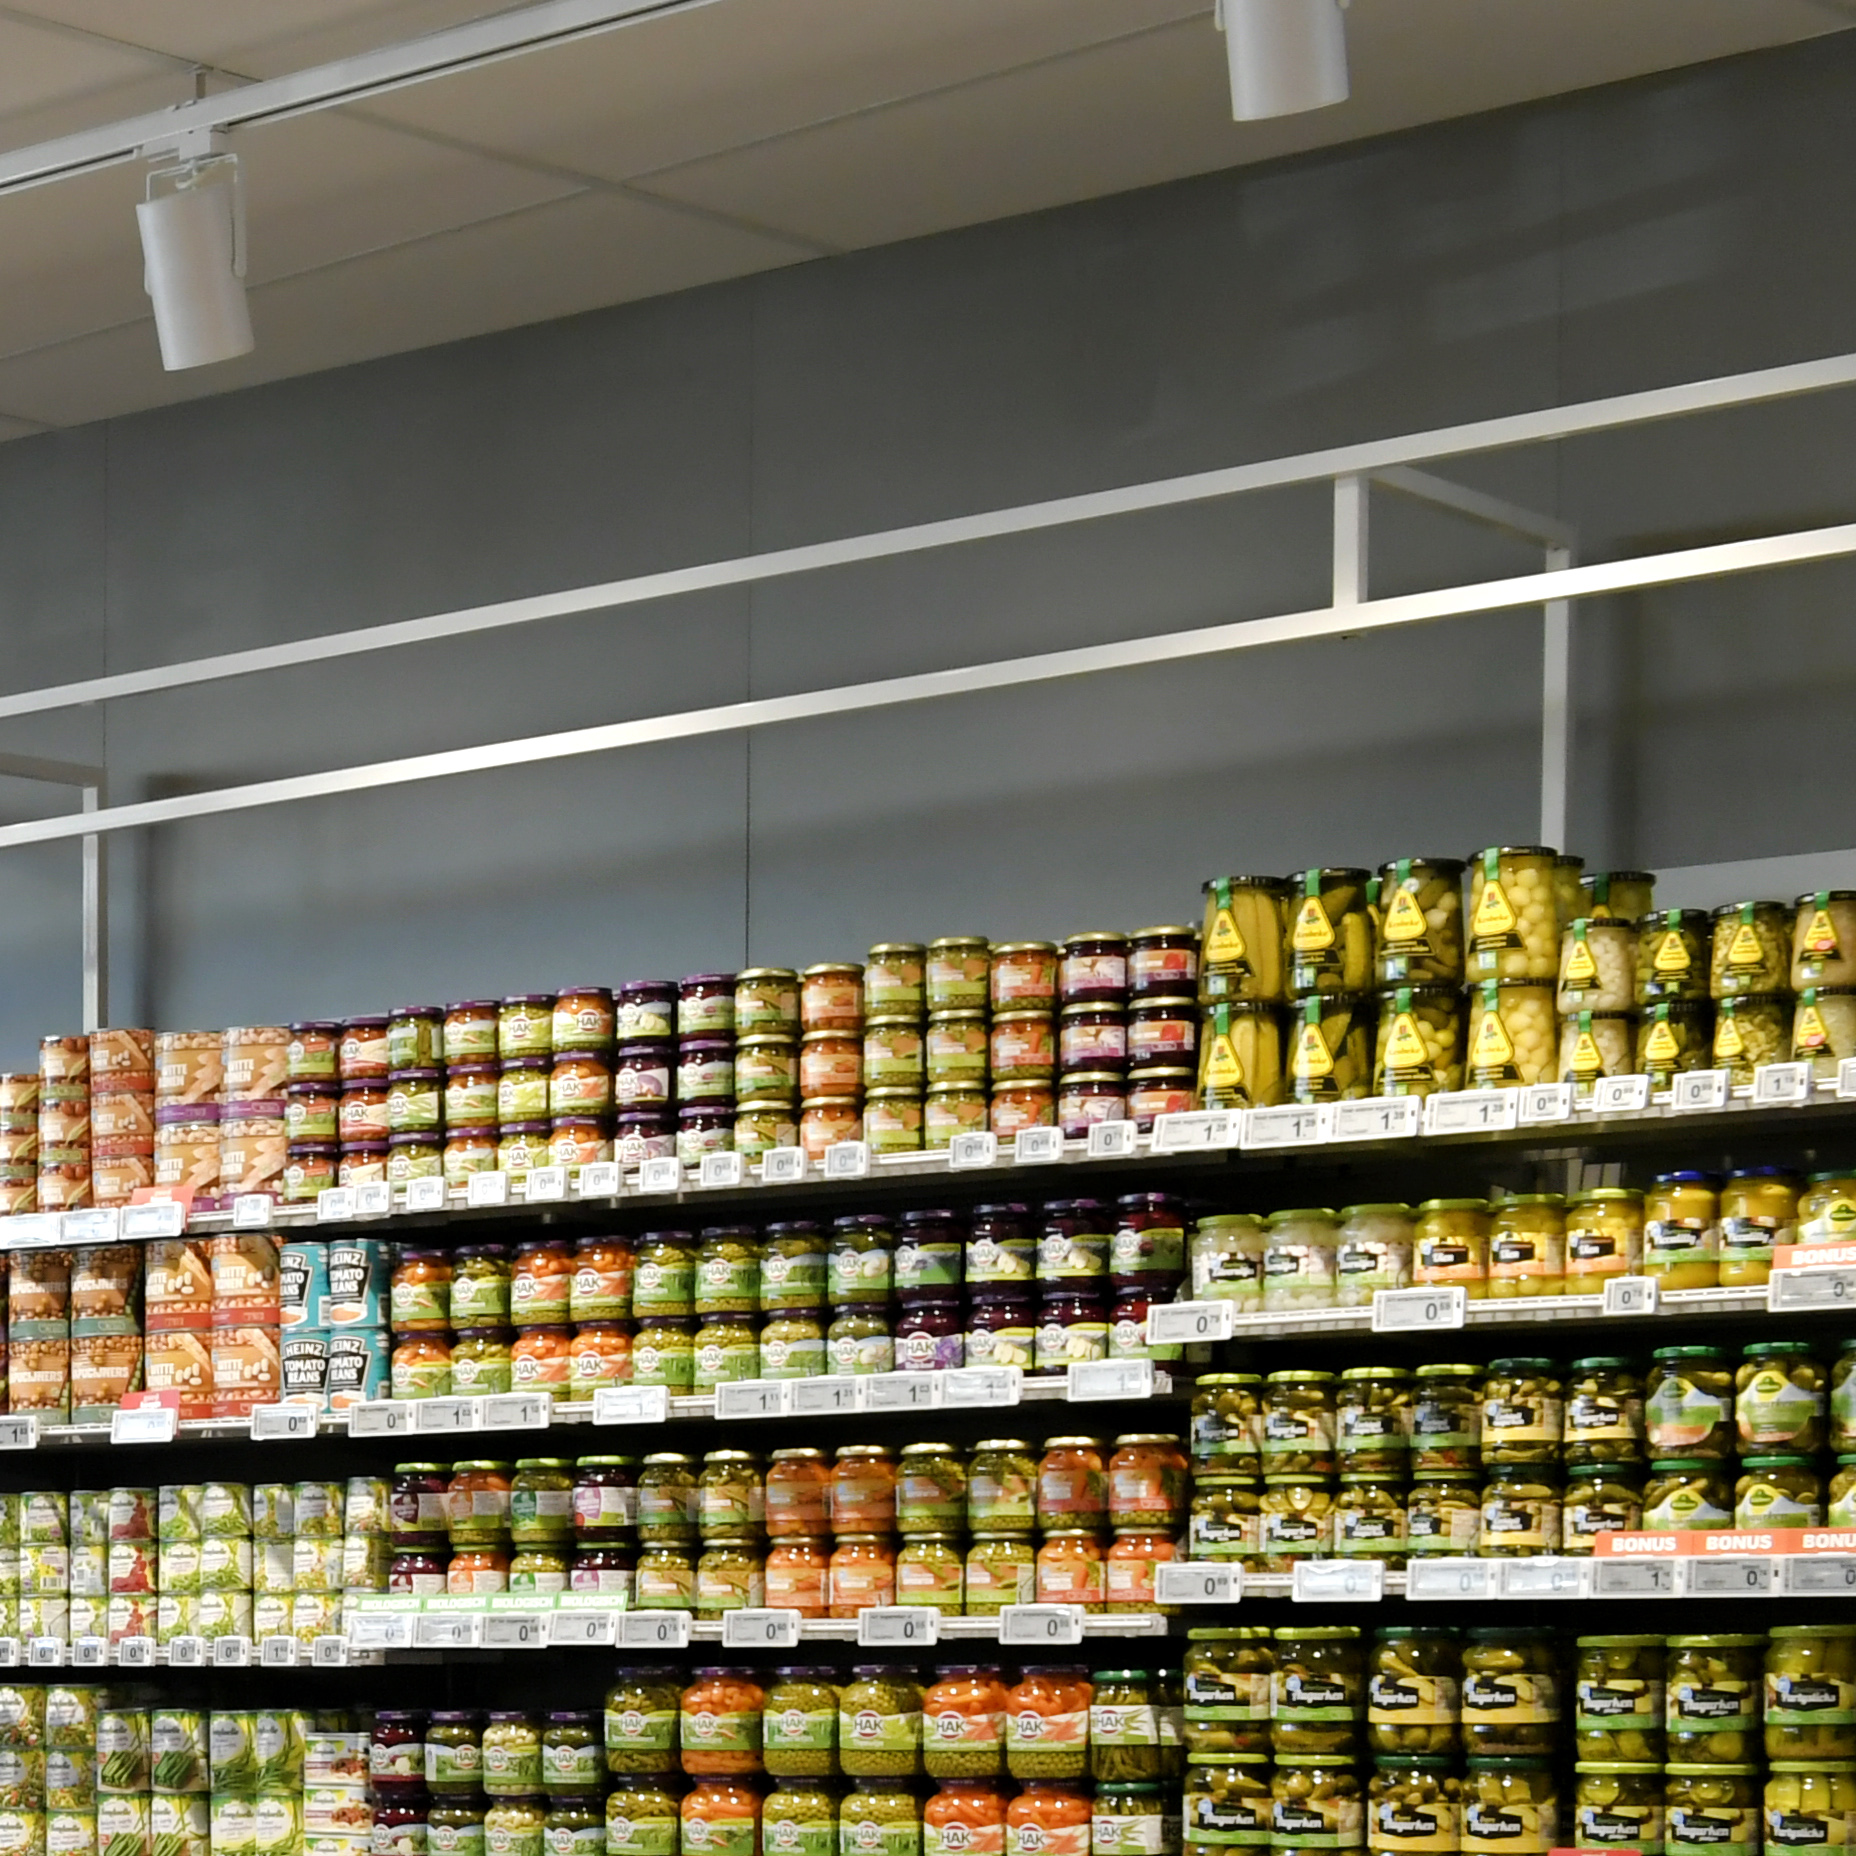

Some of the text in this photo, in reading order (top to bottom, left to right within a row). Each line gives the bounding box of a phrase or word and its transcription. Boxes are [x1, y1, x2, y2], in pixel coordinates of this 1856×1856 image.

[576, 1016, 603, 1027] HAK
[515, 1283, 536, 1293] HAK
[286, 1343, 323, 1356] HEINZ
[284, 1358, 326, 1371] TOMATO
[516, 1363, 537, 1374] HAK
[288, 1371, 320, 1383] BEANS
[1611, 1537, 1676, 1552] BONUS
[1705, 1535, 1772, 1550] BONUS
[427, 1597, 486, 1610] BIOLOGISCH
[491, 1597, 554, 1608] BIOLOGISCH
[560, 1596, 624, 1608] BIOLOGISCH
[854, 1718, 884, 1732] HAK
[935, 1719, 965, 1733] HAK
[941, 1831, 971, 1844] HAK
[1018, 1833, 1045, 1846] HAK
